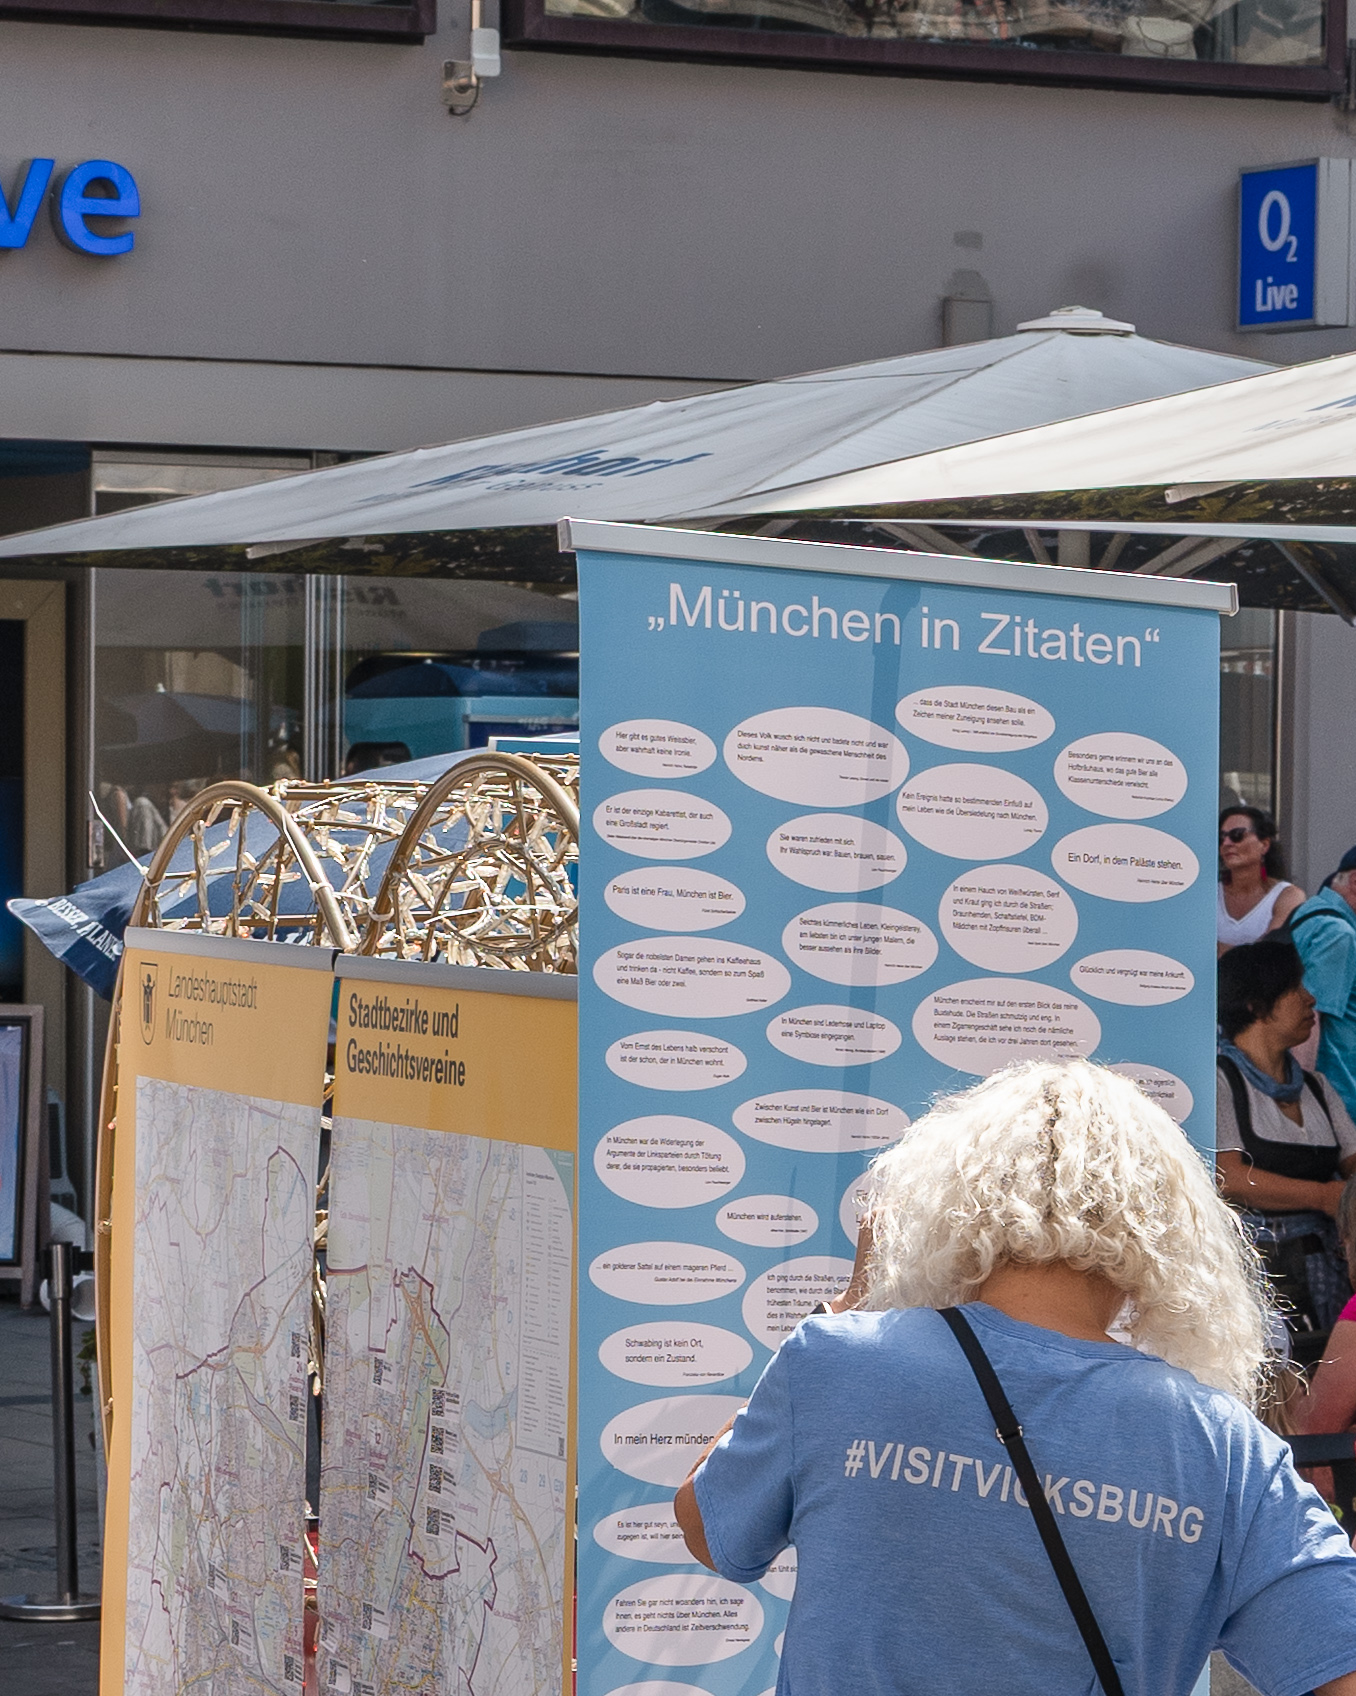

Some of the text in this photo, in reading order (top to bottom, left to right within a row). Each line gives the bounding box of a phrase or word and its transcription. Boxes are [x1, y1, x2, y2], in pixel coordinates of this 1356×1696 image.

[1255, 276, 1298, 312] Live
[647, 582, 1160, 667] „München in Zitaten“
[1082, 853, 1102, 865] Dorf,
[1129, 856, 1156, 868] Paläste
[1156, 859, 1183, 870] stehen.
[612, 884, 631, 895] Paris
[640, 887, 656, 896] eine
[656, 887, 675, 898] Frau,
[676, 888, 708, 899] München
[717, 890, 733, 901] Bier.
[168, 966, 258, 1013] Landeshauptstadt
[164, 1008, 214, 1046] München
[349, 992, 459, 1039] Stadtbezirke und
[346, 1038, 466, 1087] Geschichtsvereine
[625, 1338, 663, 1350] Schwabing
[673, 1339, 689, 1348] kein
[689, 1338, 704, 1349] Ort,
[625, 1354, 653, 1363] sondern
[666, 1353, 696, 1363] Zustand.
[624, 1433, 649, 1445] mein
[649, 1433, 673, 1445] Herz
